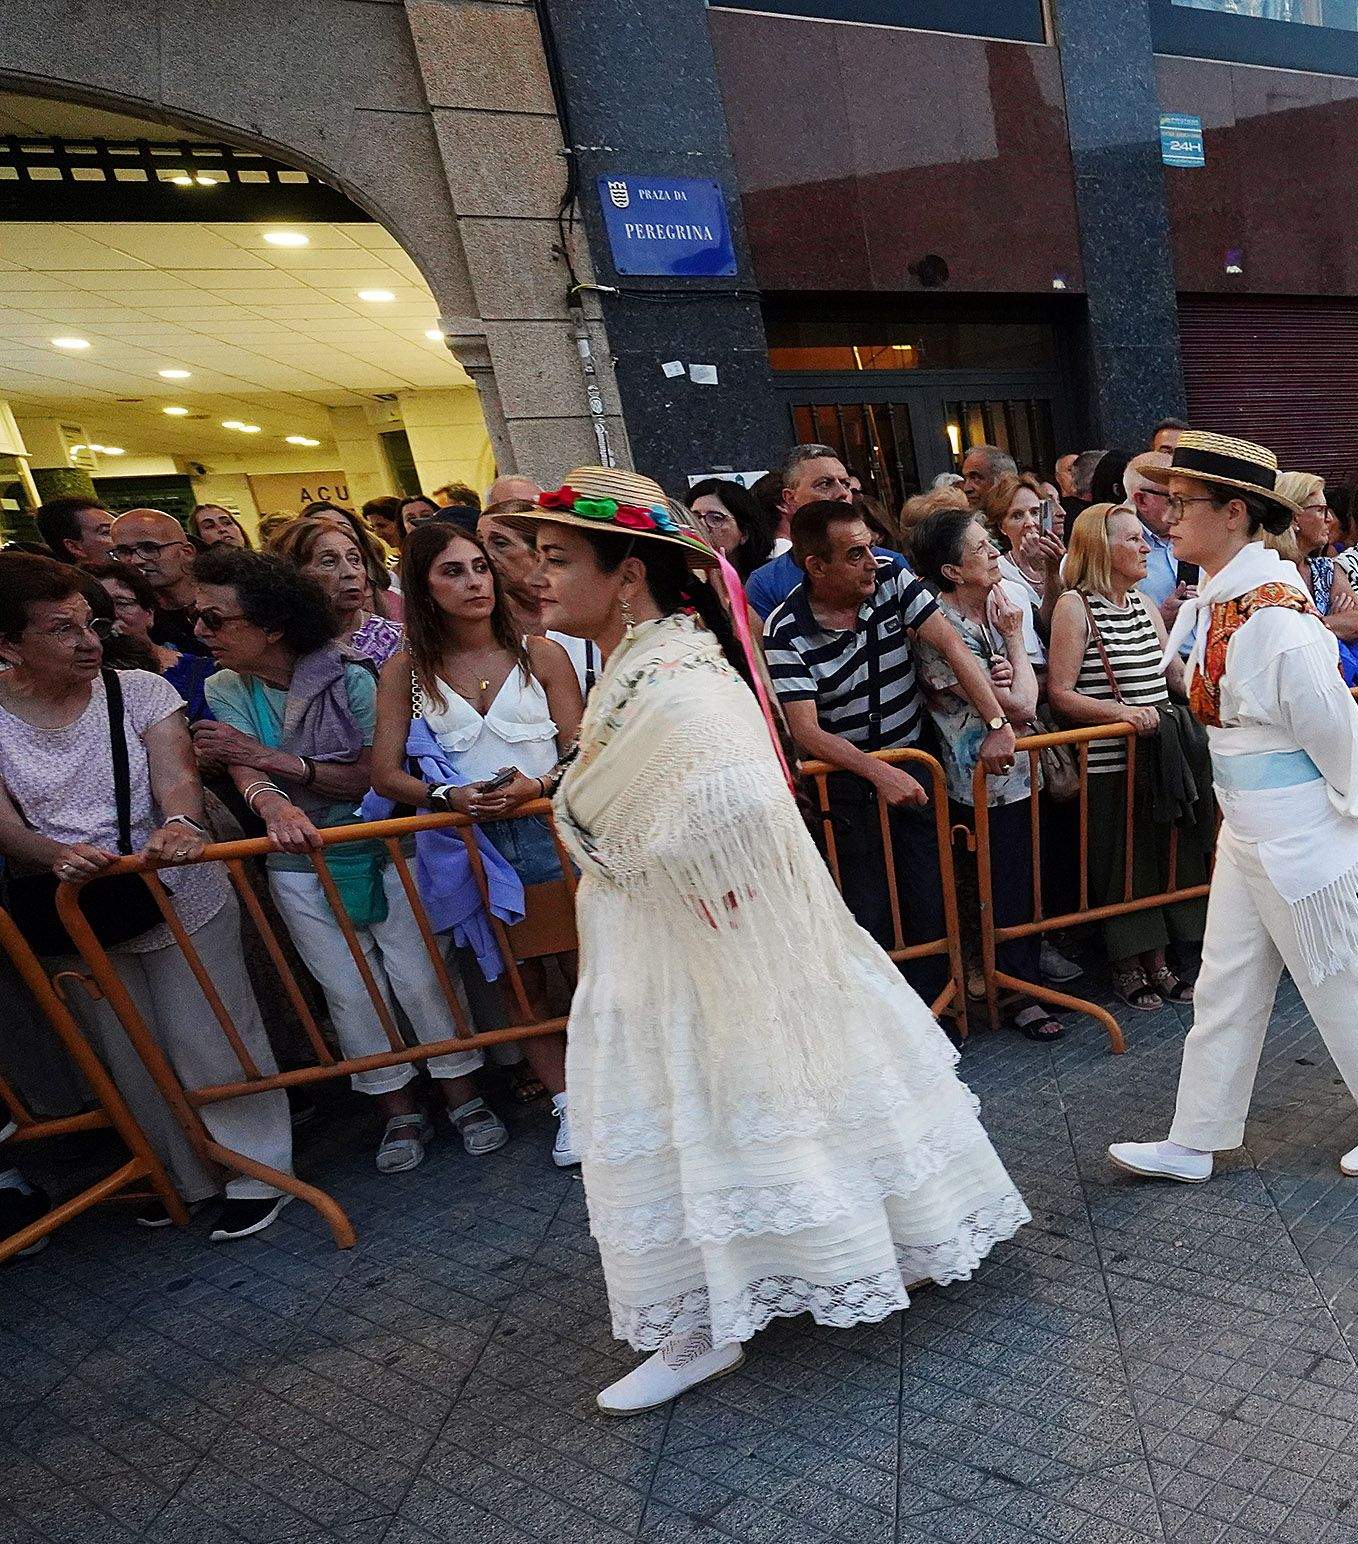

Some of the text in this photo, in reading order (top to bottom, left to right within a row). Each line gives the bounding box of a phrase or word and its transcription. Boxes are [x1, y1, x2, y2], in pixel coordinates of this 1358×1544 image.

[1170, 140, 1201, 152] 24H
[638, 189, 687, 201] PRAZA DA
[625, 223, 713, 241] PEREGRINA
